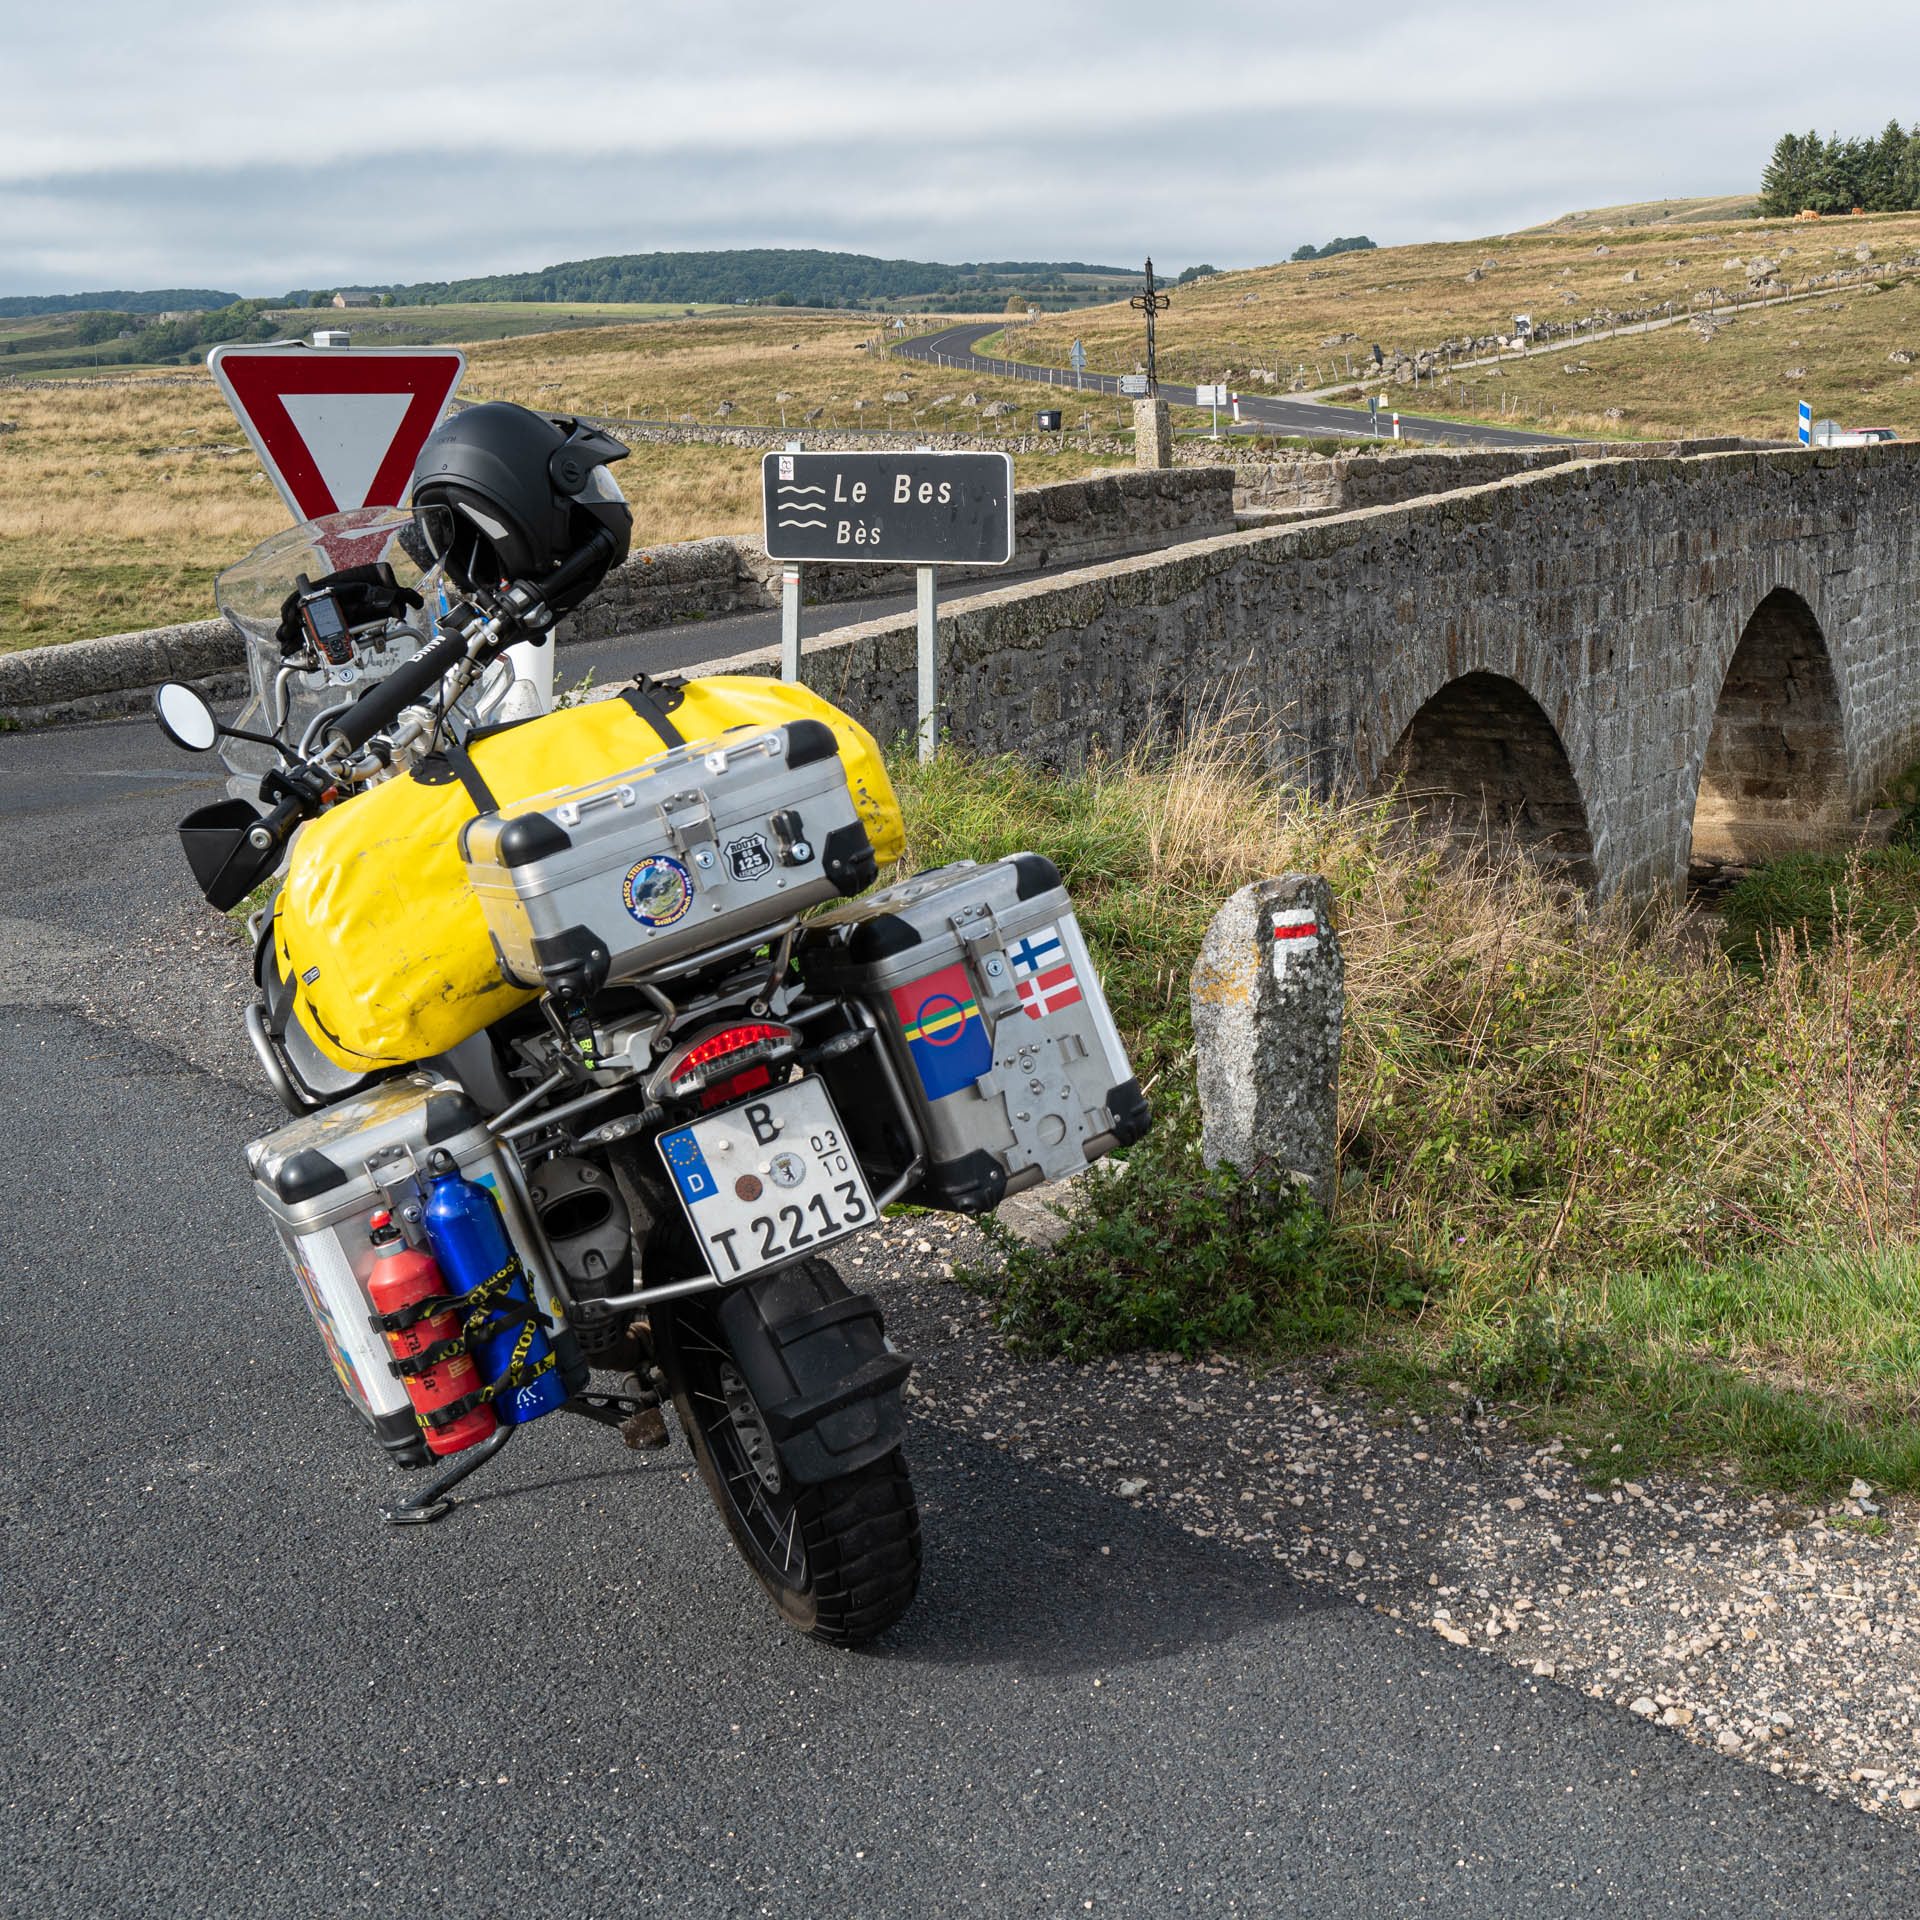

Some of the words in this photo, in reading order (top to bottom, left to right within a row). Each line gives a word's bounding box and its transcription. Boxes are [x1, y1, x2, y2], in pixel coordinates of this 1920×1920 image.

[833, 473, 868, 503] Le
[893, 474, 952, 505] Bes
[836, 519, 881, 545] Bès
[729, 836, 761, 853] ROUTE
[626, 858, 655, 881] STELVIO
[737, 855, 763, 871] 125
[624, 880, 634, 909] PASSO
[744, 1102, 781, 1146] B
[809, 1130, 838, 1153] 03
[822, 1155, 848, 1177] 10
[687, 1173, 705, 1193] D
[710, 1228, 740, 1272] T
[750, 1180, 866, 1260] 2213
